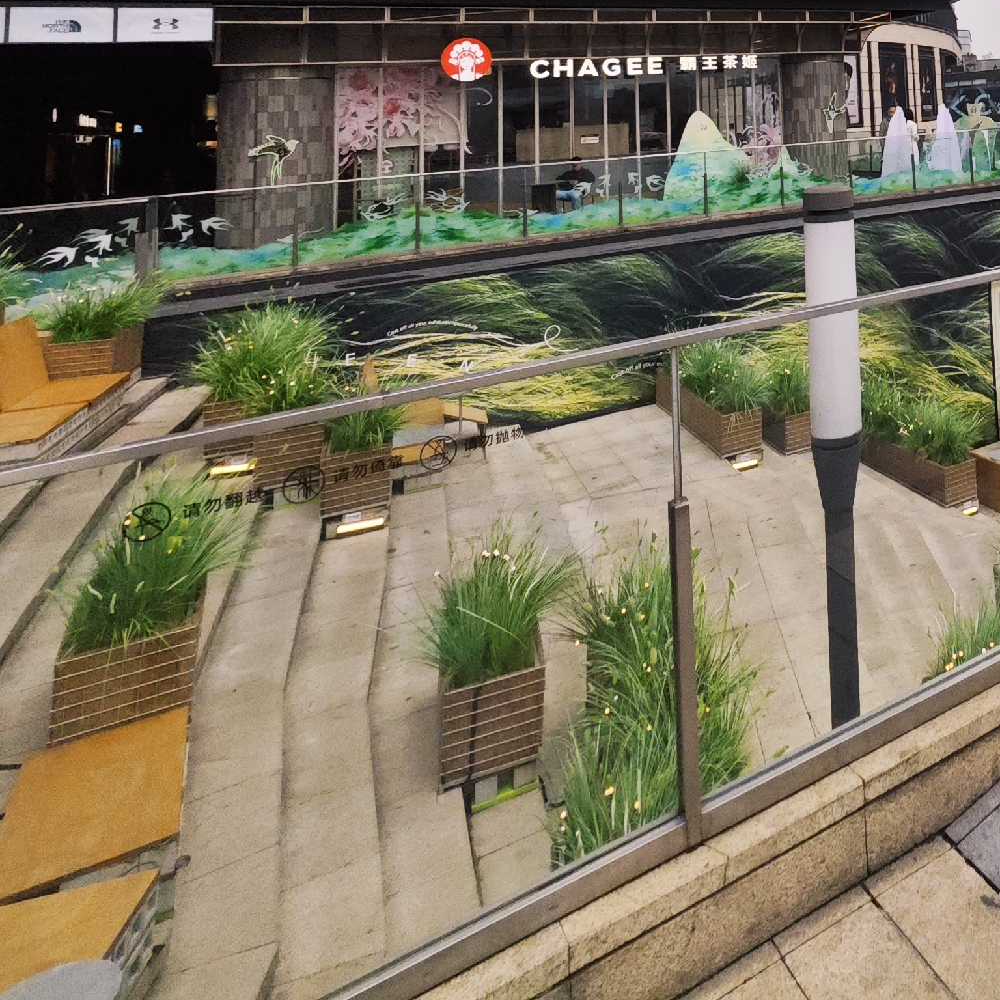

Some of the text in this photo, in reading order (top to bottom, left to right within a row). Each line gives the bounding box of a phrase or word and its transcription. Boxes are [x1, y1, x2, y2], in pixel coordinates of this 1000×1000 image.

[530, 56, 663, 79] CHAGEE
[679, 54, 758, 72] 霸王茶姬
